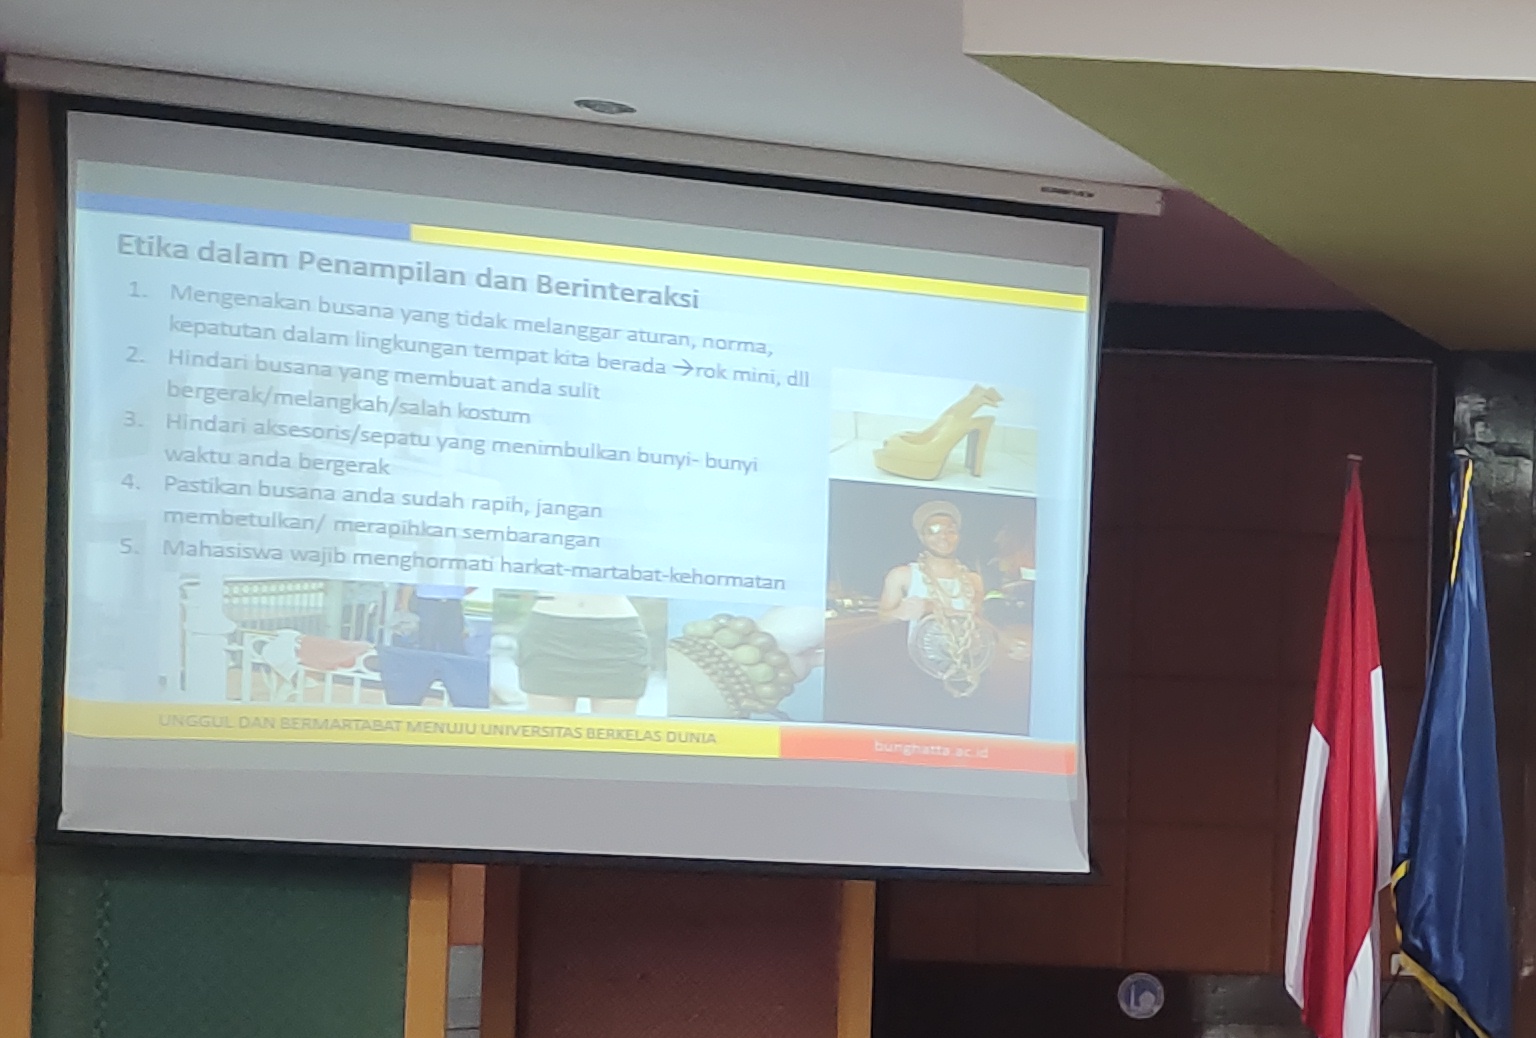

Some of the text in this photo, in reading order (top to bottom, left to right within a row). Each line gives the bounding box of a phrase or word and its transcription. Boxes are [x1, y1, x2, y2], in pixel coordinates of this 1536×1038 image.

[117, 232, 700, 309] Etika dalam Penampilan dan Berinteraksi
[129, 281, 774, 358] 1. Mengenakan busana yang tidak melanggar aturan, norma,
[126, 346, 601, 401] 2. Hindari busana yang membuat anda sulit
[169, 315, 277, 344] kepatutan
[283, 324, 350, 347] dalam
[355, 330, 468, 359] lingkungan
[473, 343, 549, 367] tempat
[554, 346, 592, 367] kita
[597, 352, 667, 376] berada
[733, 366, 782, 388] mini,
[786, 368, 811, 388] dll
[167, 381, 531, 426] bergerak/melangkah/salah kostum
[123, 411, 759, 475] 3. Hindari aksesoris/sepatu yang menimbulkan bunyi- bunyi
[165, 446, 391, 477] waktu anda bergerak
[121, 474, 602, 521] 4. Pastikan busana anda sudah rapih, jangan
[163, 508, 601, 550] membetulkan/ merapihkan sembarangan
[120, 538, 786, 591] 5. Mahasiswa wajib menghormati harkat-martabat-kehormatan
[159, 714, 717, 745] UNGGUL DAN BERMARTABAT MENUJU UNIVERSITAS BERKELAS DUNIA
